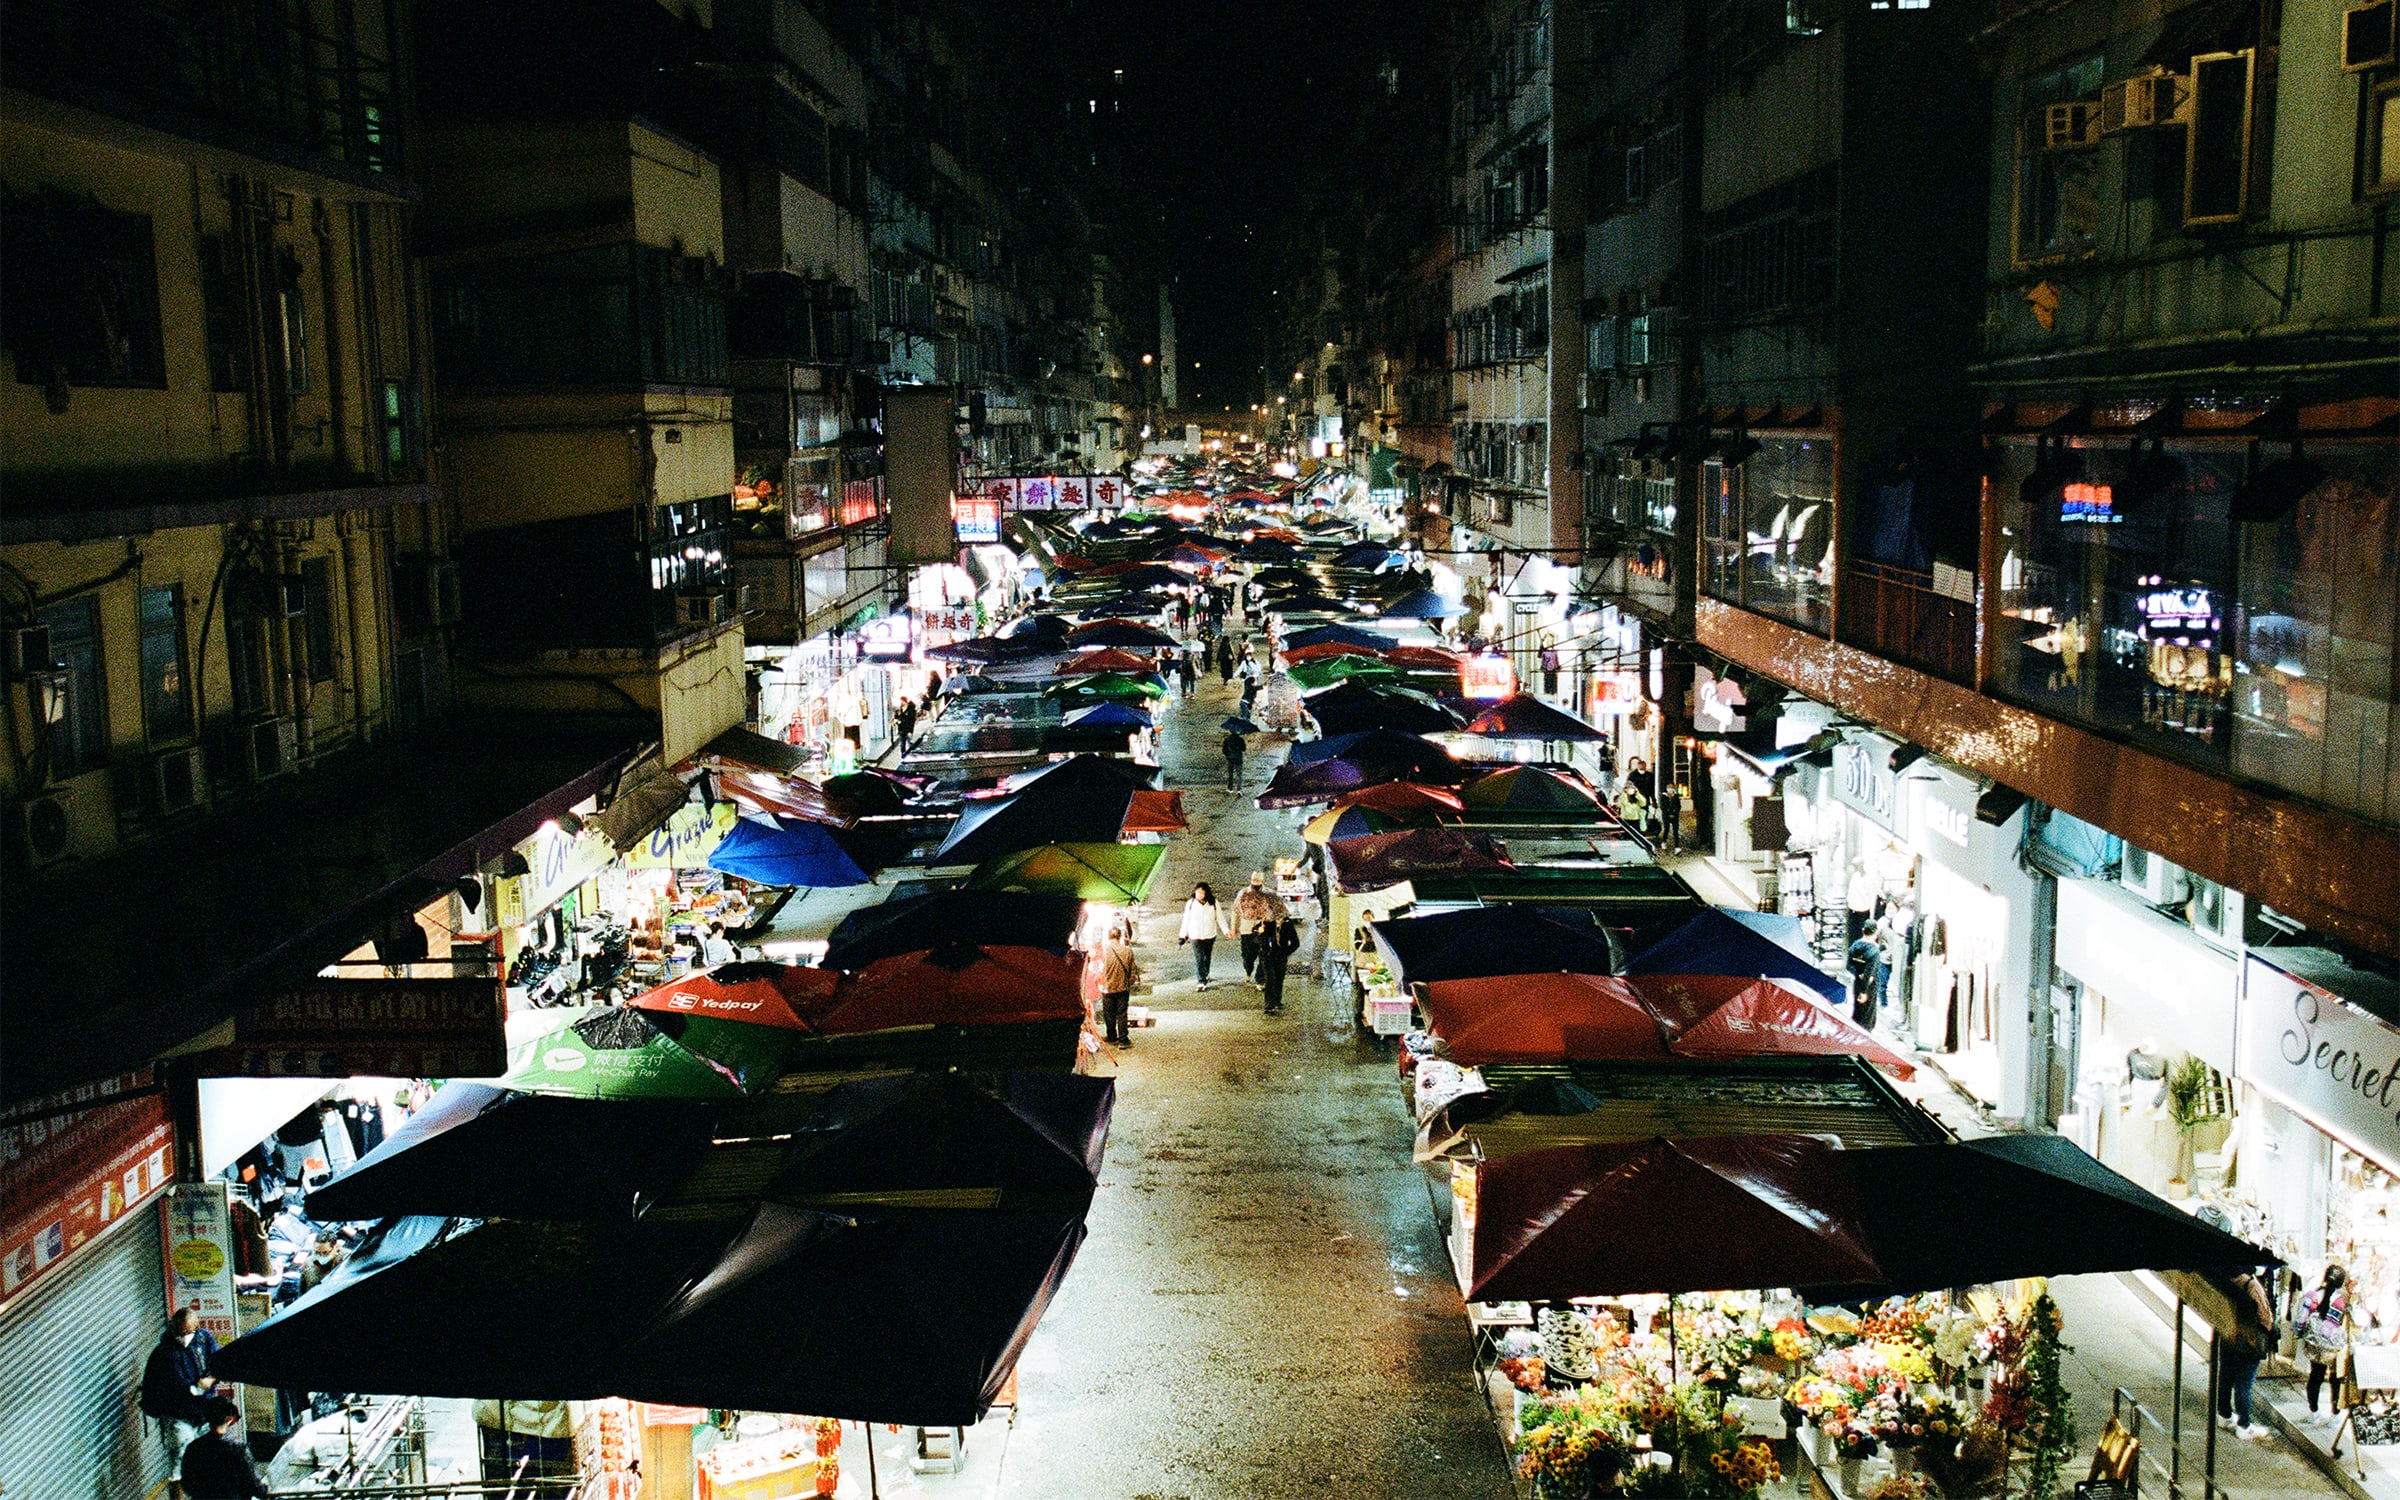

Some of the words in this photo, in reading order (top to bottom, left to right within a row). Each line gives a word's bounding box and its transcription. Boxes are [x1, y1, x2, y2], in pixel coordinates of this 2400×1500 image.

[701, 999, 764, 1012] Yedpay
[593, 1054, 665, 1068] 微信支付
[590, 1066, 636, 1077] WeChat
[639, 1068, 660, 1078] Pay
